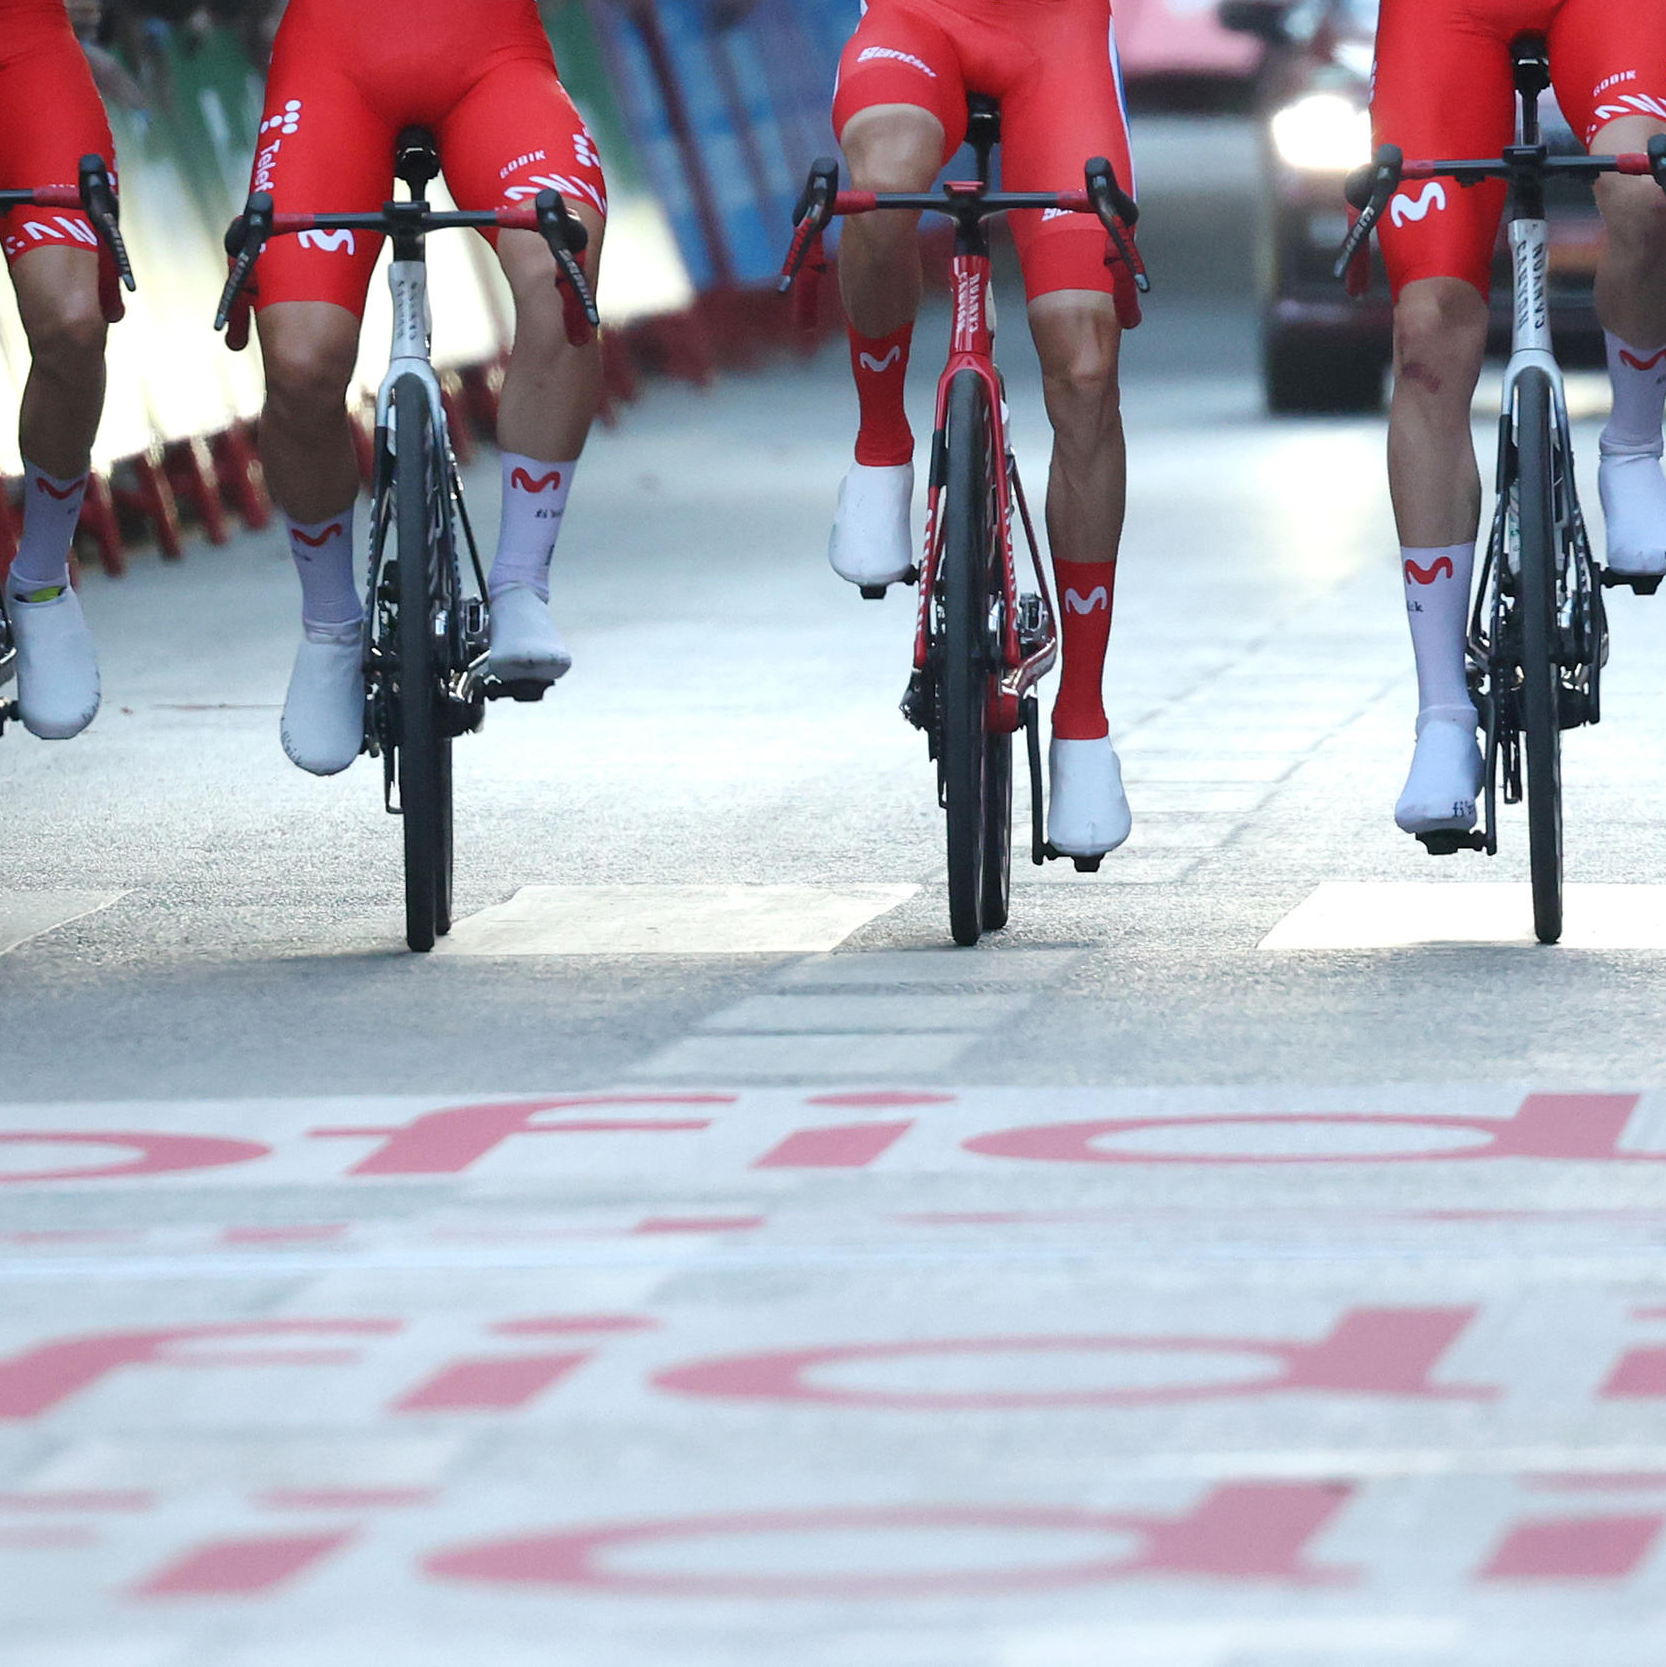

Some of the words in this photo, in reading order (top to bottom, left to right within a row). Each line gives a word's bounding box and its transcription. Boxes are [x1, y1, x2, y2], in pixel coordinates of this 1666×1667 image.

[856, 46, 938, 78] Santini
[1516, 239, 1529, 333] CANYON
[1532, 241, 1546, 331] CANYON
